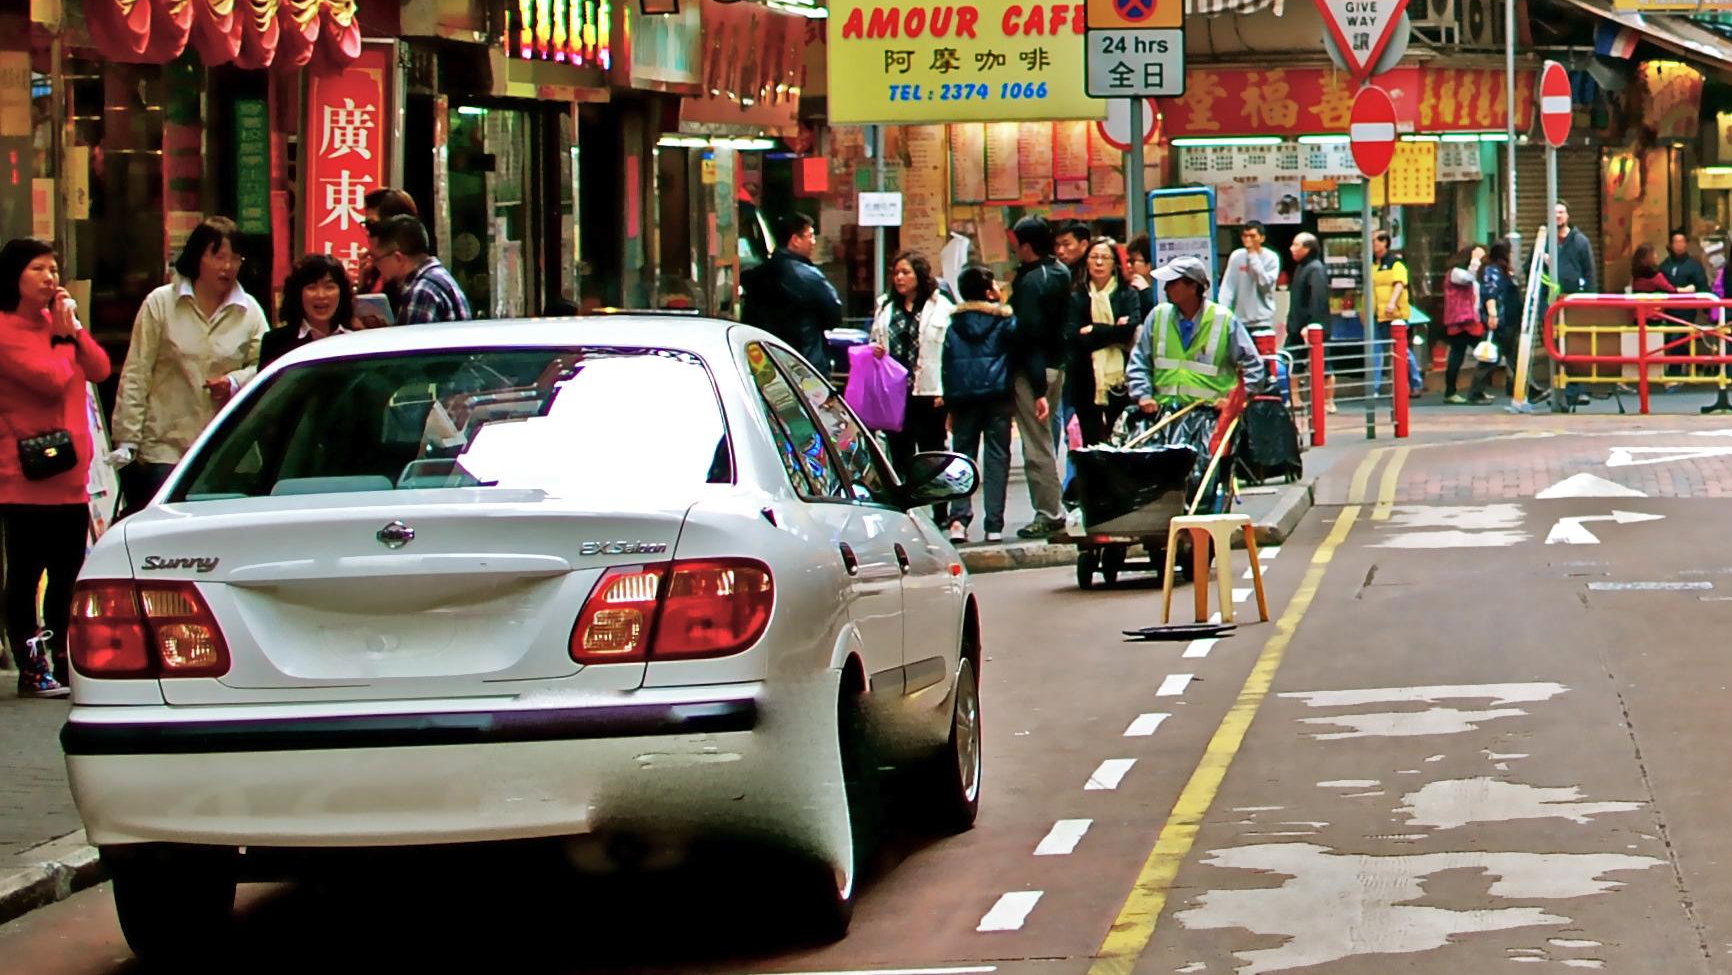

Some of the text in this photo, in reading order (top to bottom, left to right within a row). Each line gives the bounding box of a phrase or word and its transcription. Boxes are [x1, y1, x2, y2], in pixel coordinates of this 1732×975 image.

[1345, 1, 1378, 13] GIVE
[842, 4, 1085, 40] AMOUR CAFE
[1345, 16, 1377, 27] WAY
[1102, 35, 1169, 54] 24 hrs
[884, 47, 1052, 75] 阿摩咖啡
[1108, 60, 1165, 89] 全日
[940, 83, 988, 101] 2374
[1000, 81, 1049, 100] 1066
[141, 555, 220, 573] Sunny
